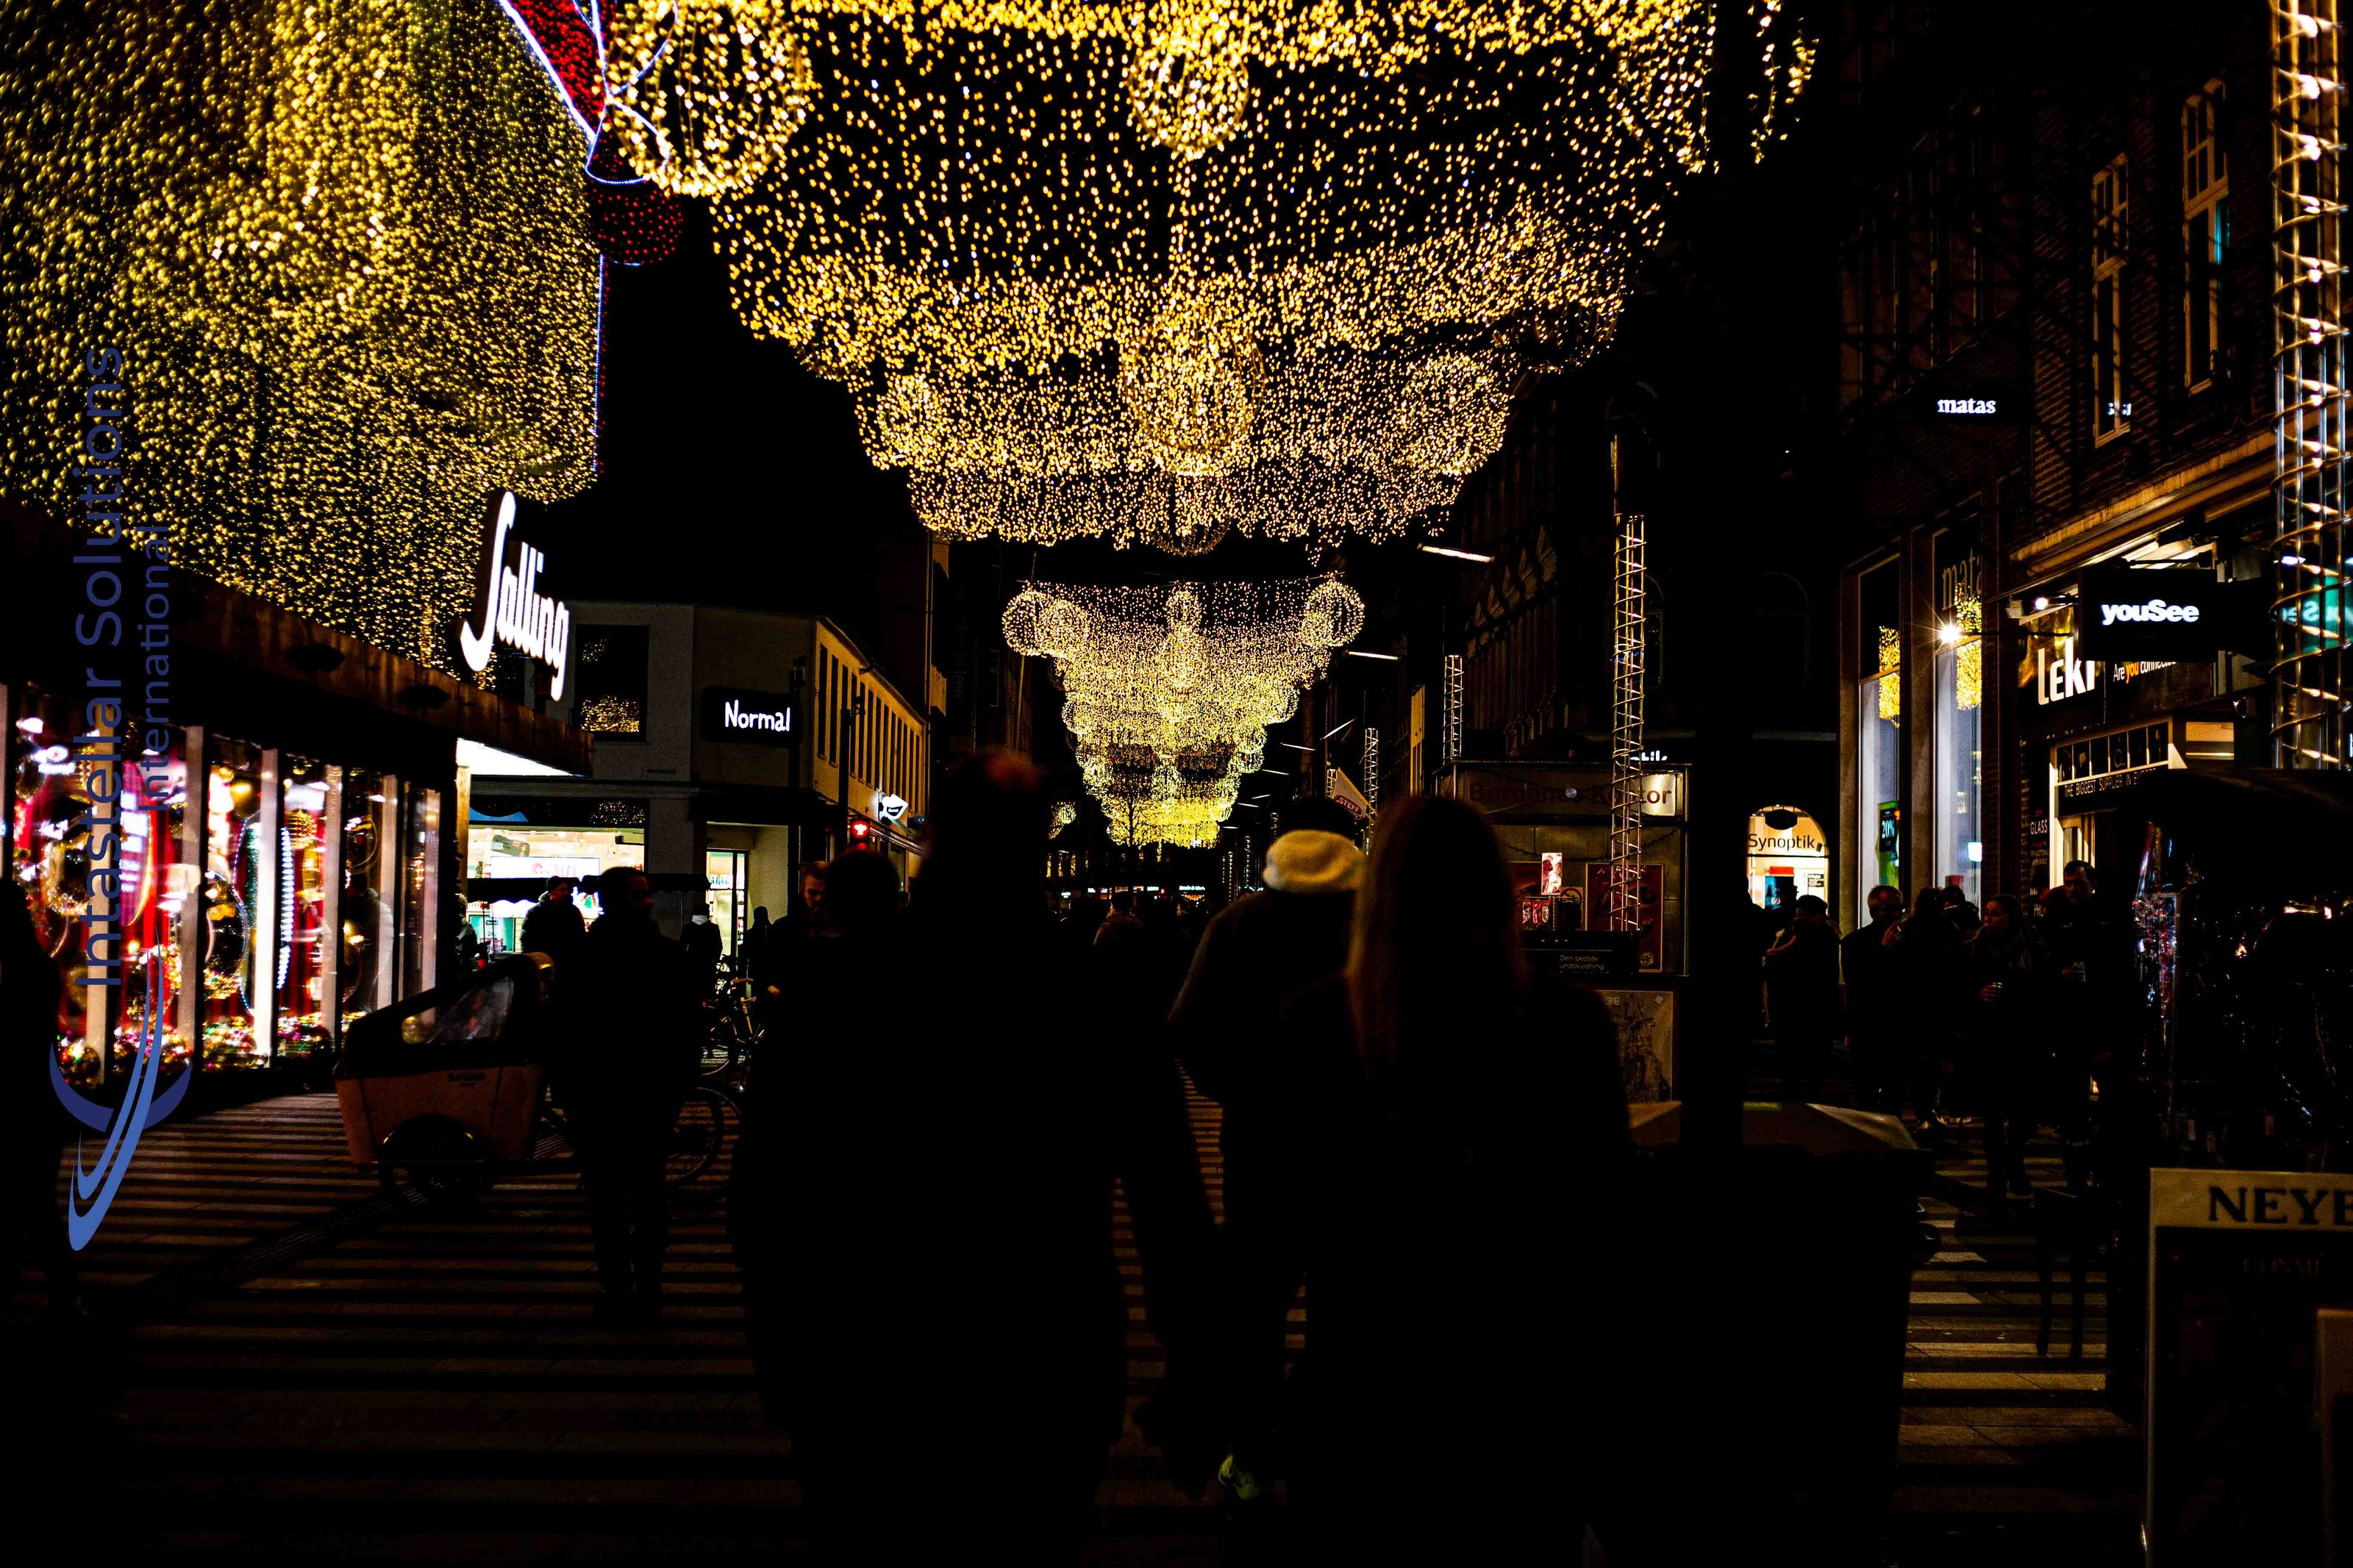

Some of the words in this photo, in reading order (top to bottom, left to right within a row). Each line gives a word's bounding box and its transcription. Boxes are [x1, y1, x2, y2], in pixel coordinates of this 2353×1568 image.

[1937, 398, 1996, 414] matas
[460, 491, 570, 701] Salling
[2101, 599, 2200, 626] youSee
[2113, 663, 2125, 682] Are
[2126, 662, 2139, 684] you
[724, 699, 791, 732] Normal
[2064, 784, 2074, 798] THE
[2076, 779, 2096, 796] BIGGEST
[1882, 820, 1895, 838] 20%
[2030, 819, 2048, 836] GLASS
[1748, 833, 1815, 851] Synoptik
